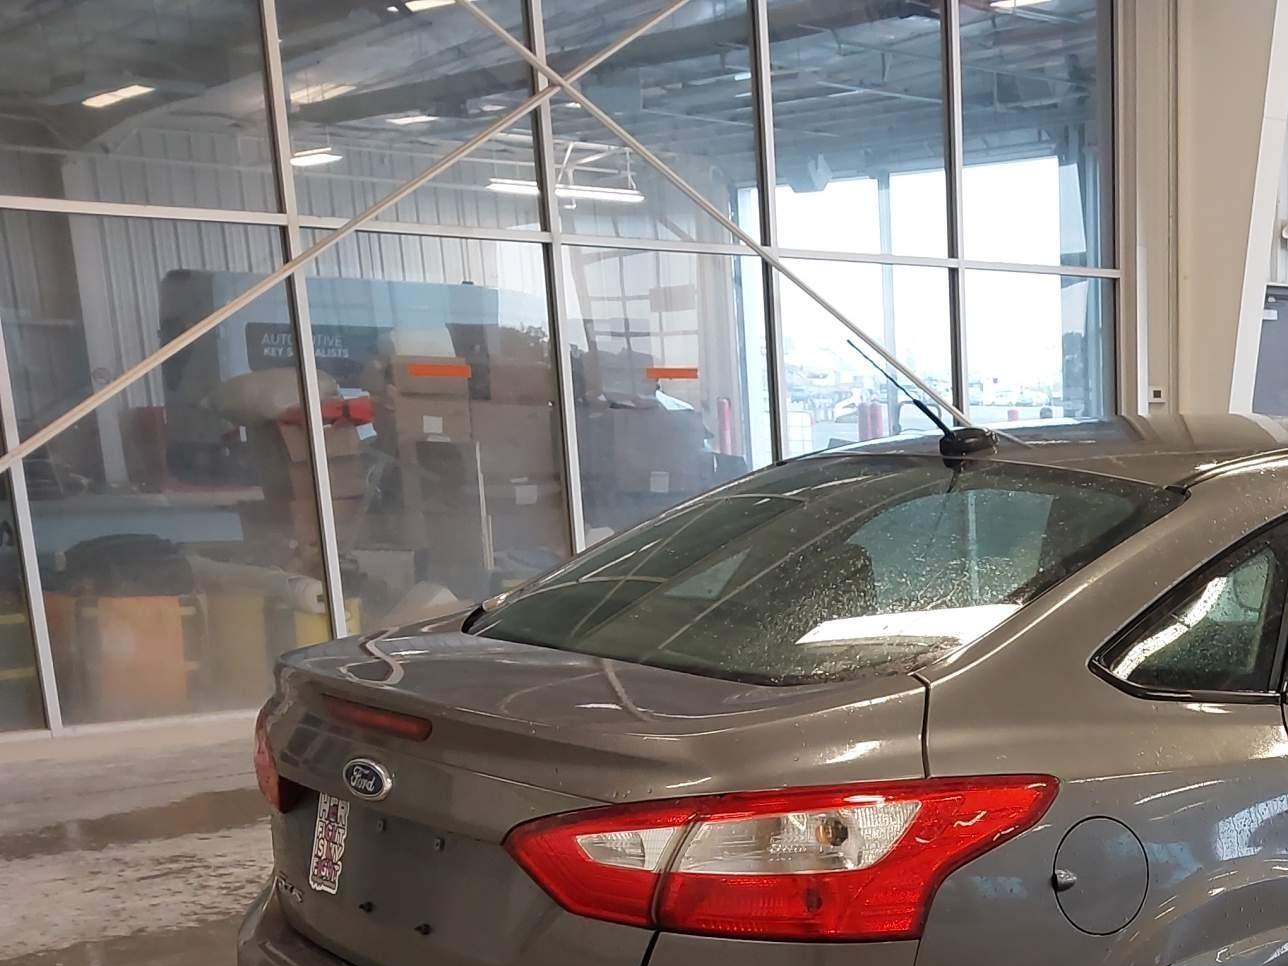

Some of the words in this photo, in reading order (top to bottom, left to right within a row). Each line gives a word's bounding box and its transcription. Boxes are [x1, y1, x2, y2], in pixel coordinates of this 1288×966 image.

[261, 333, 342, 347] AUTOTIVE
[264, 347, 283, 357] KEY
[287, 347, 348, 358] SALISTS
[351, 766, 376, 791] Ford
